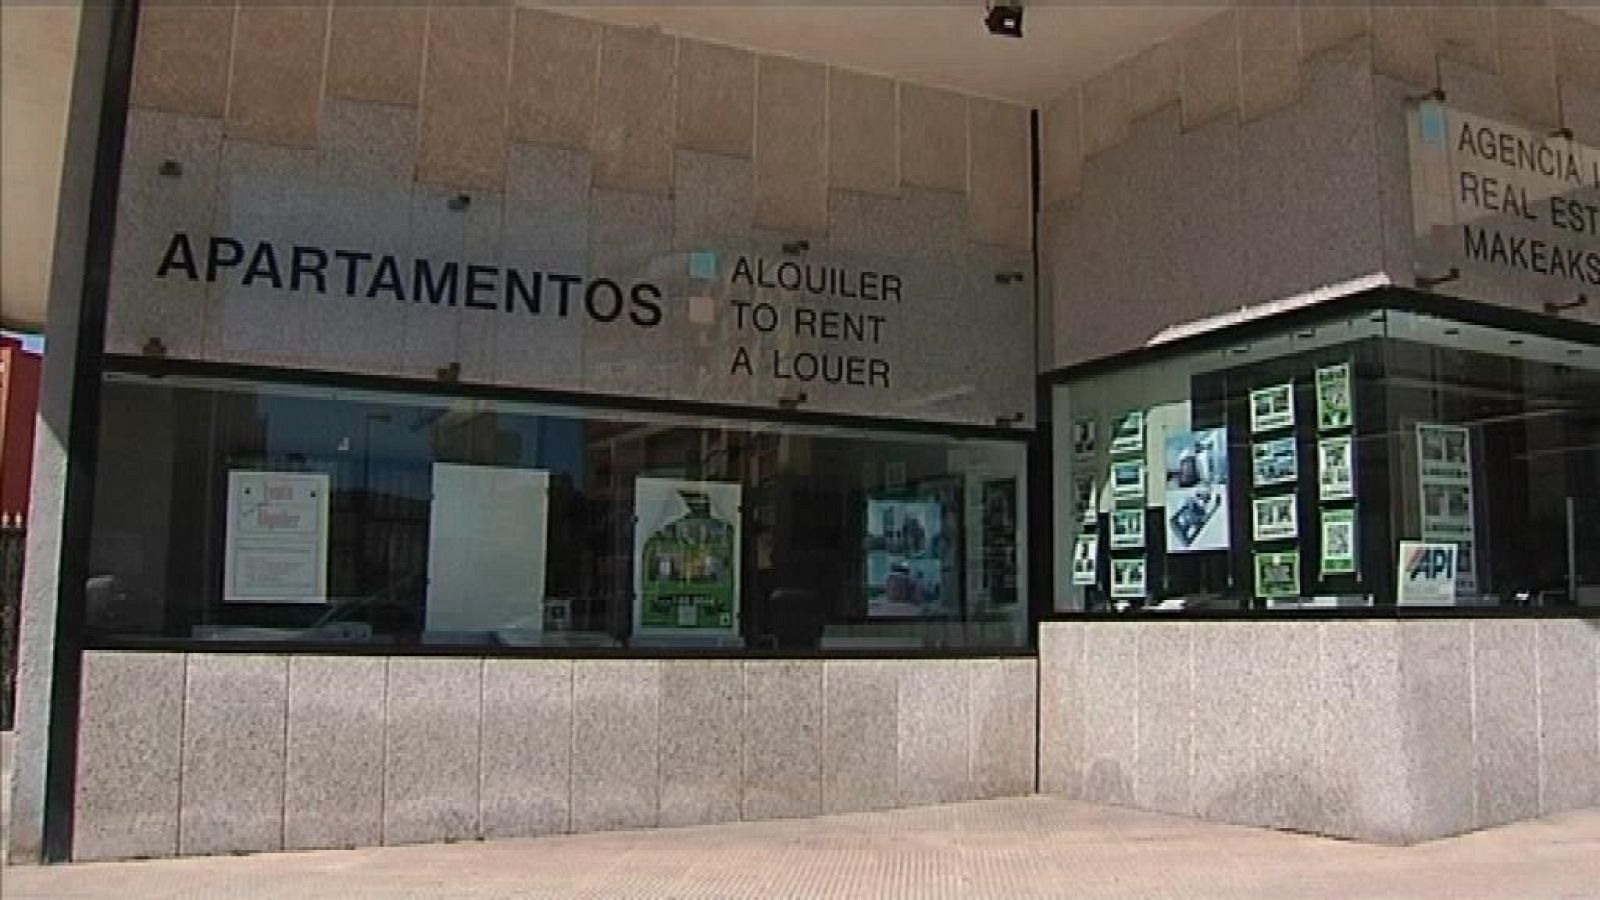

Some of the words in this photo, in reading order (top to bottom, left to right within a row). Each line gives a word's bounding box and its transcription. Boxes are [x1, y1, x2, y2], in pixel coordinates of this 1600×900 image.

[1458, 121, 1581, 185] AGENCIA
[1460, 171, 1538, 219] REAL
[156, 233, 662, 327] APARTAMENTOS
[731, 256, 902, 303] ALQUILER
[730, 300, 778, 332] TO
[795, 308, 886, 344] RENT
[731, 346, 753, 376] A
[773, 350, 890, 388] LOUER
[1407, 547, 1454, 581] API
